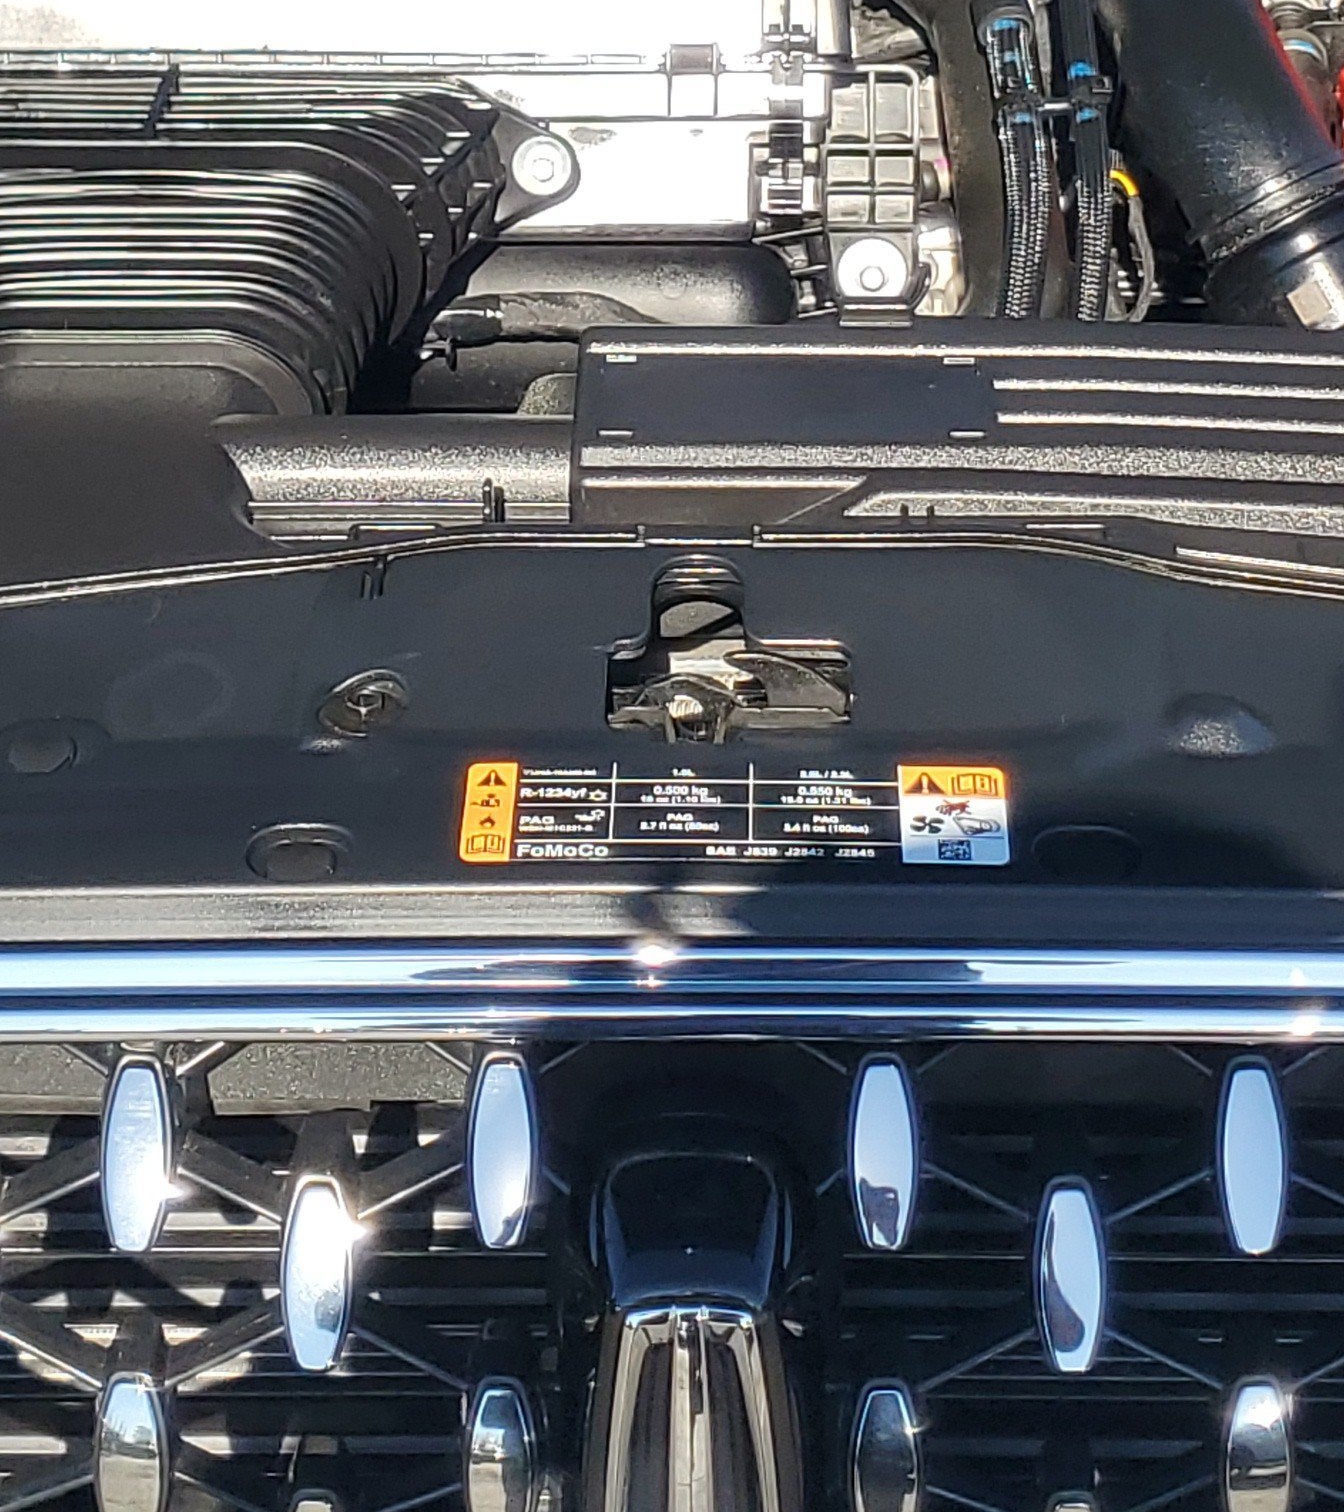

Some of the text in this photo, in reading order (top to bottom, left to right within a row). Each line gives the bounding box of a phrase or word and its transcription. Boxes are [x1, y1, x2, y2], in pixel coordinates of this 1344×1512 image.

[520, 787, 587, 799] R-1234yf
[653, 785, 689, 795] 0.500
[797, 786, 833, 796] 0.550
[519, 815, 554, 824] PAG
[517, 844, 608, 857] FoMoCo
